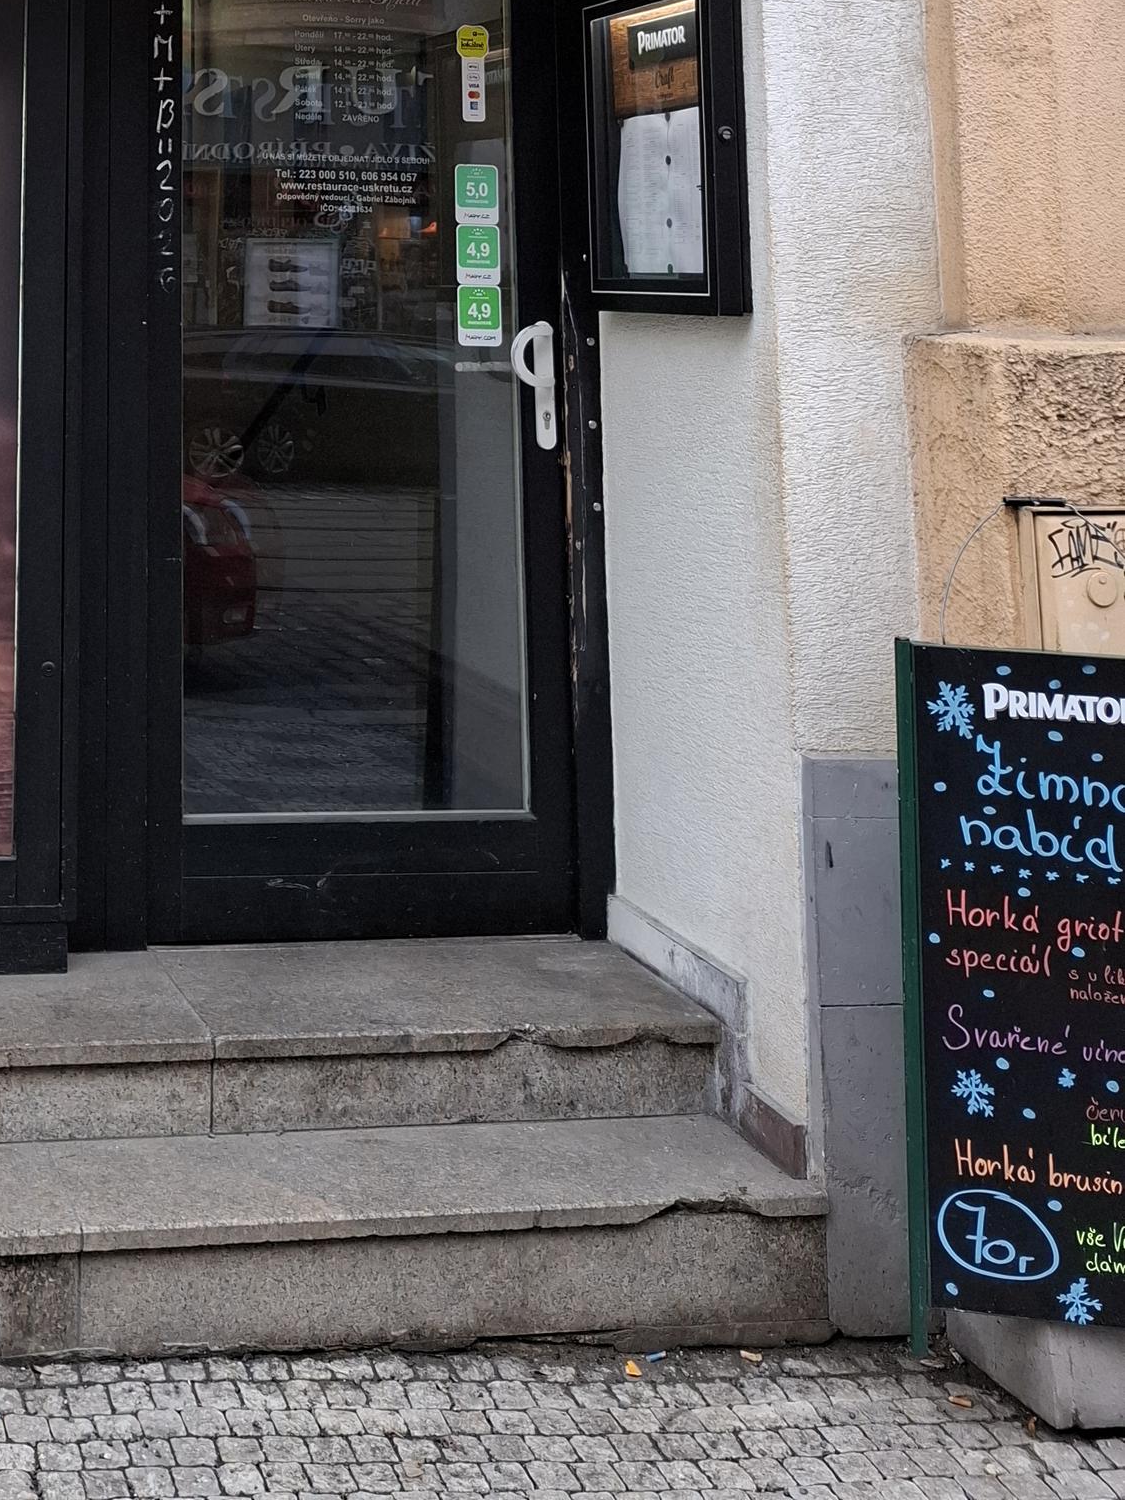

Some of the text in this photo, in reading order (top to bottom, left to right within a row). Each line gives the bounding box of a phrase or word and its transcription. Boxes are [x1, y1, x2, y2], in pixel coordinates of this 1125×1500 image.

[275, 168, 418, 182] Tel.: 223 000 510, 606 954 057
[280, 182, 413, 194] www.restaurace-uskretu.cz
[466, 181, 488, 199] 5,0
[466, 242, 490, 259] 4,9
[467, 302, 491, 320] 4,9
[982, 683, 1125, 725] PRIMATO
[947, 889, 1039, 933] Horká
[945, 944, 1052, 978] speciál
[942, 1004, 1070, 1056] Svařené
[955, 1138, 1036, 1183] Horká
